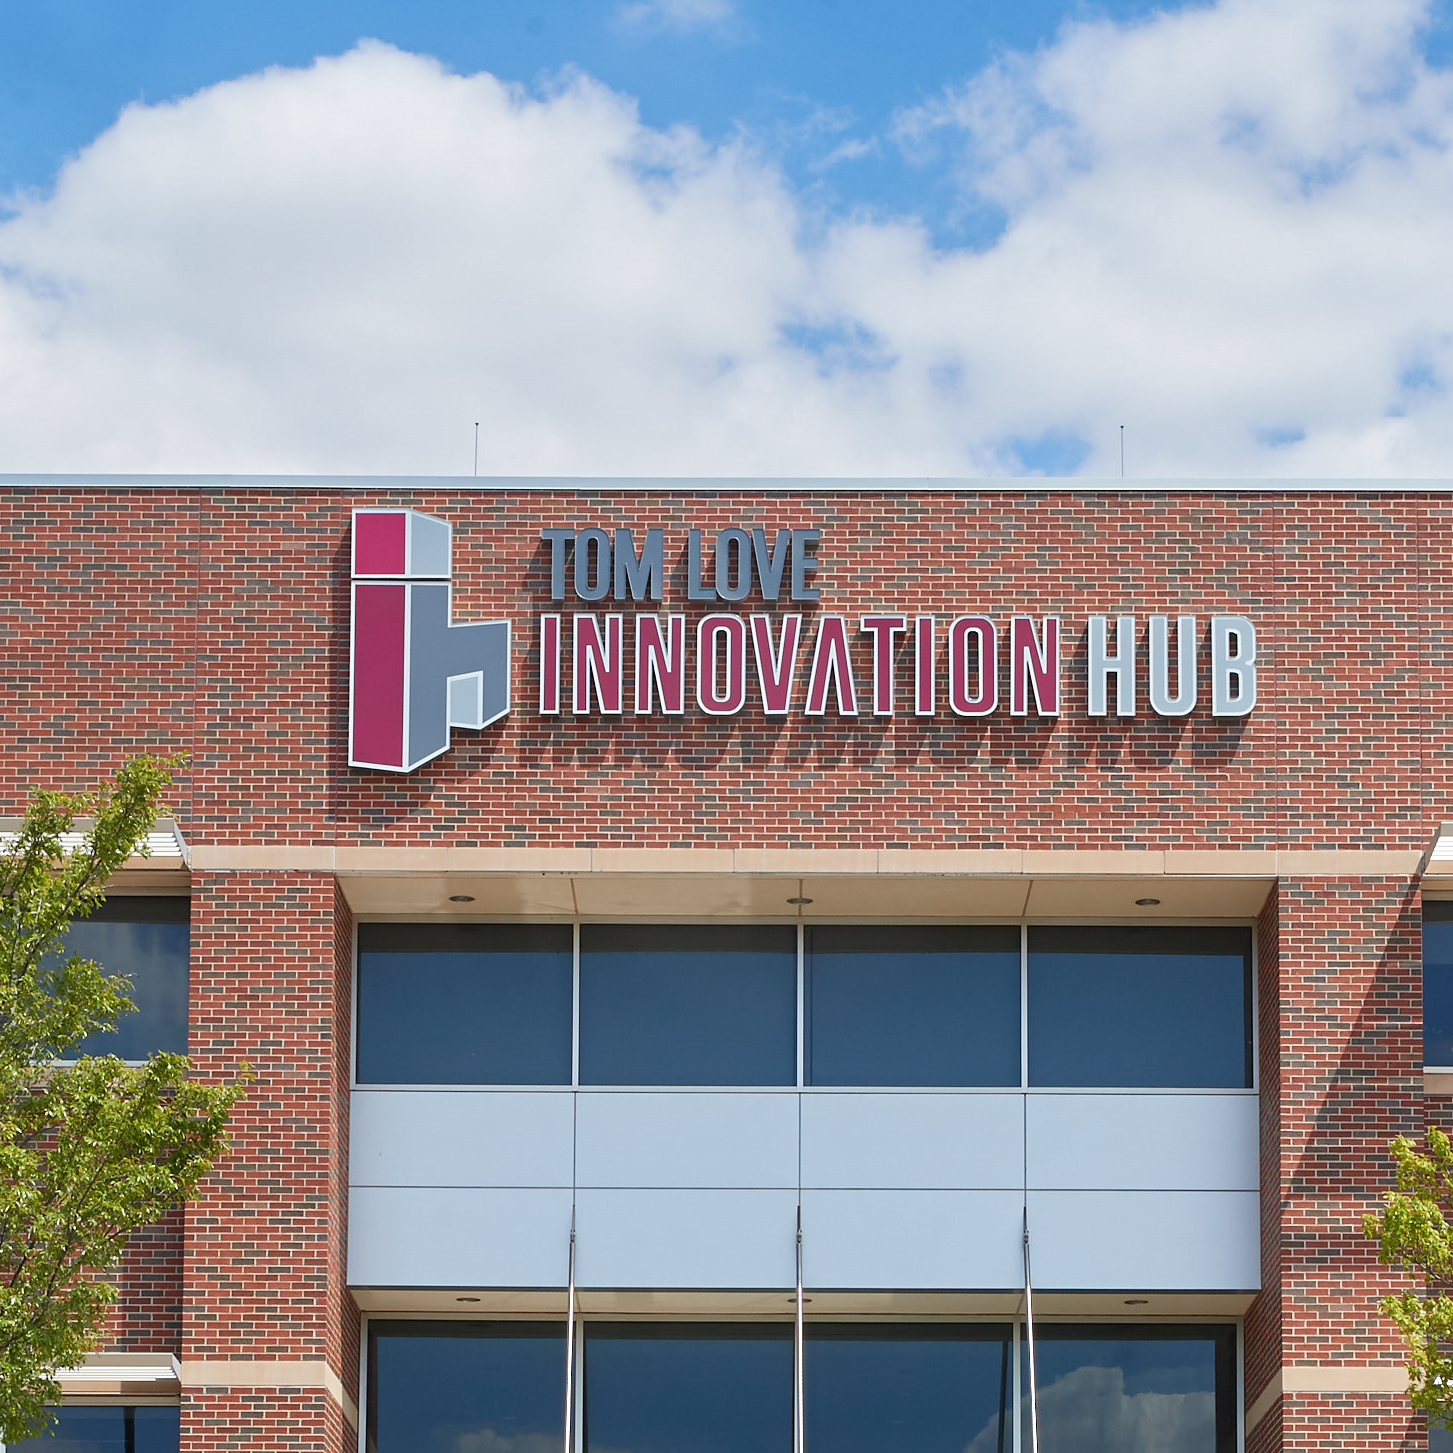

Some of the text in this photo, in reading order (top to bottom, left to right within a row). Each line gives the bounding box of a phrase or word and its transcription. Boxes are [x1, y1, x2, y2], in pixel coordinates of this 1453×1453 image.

[541, 527, 821, 601] TOM LOVE
[539, 613, 1258, 717] INNOVATION HUB
